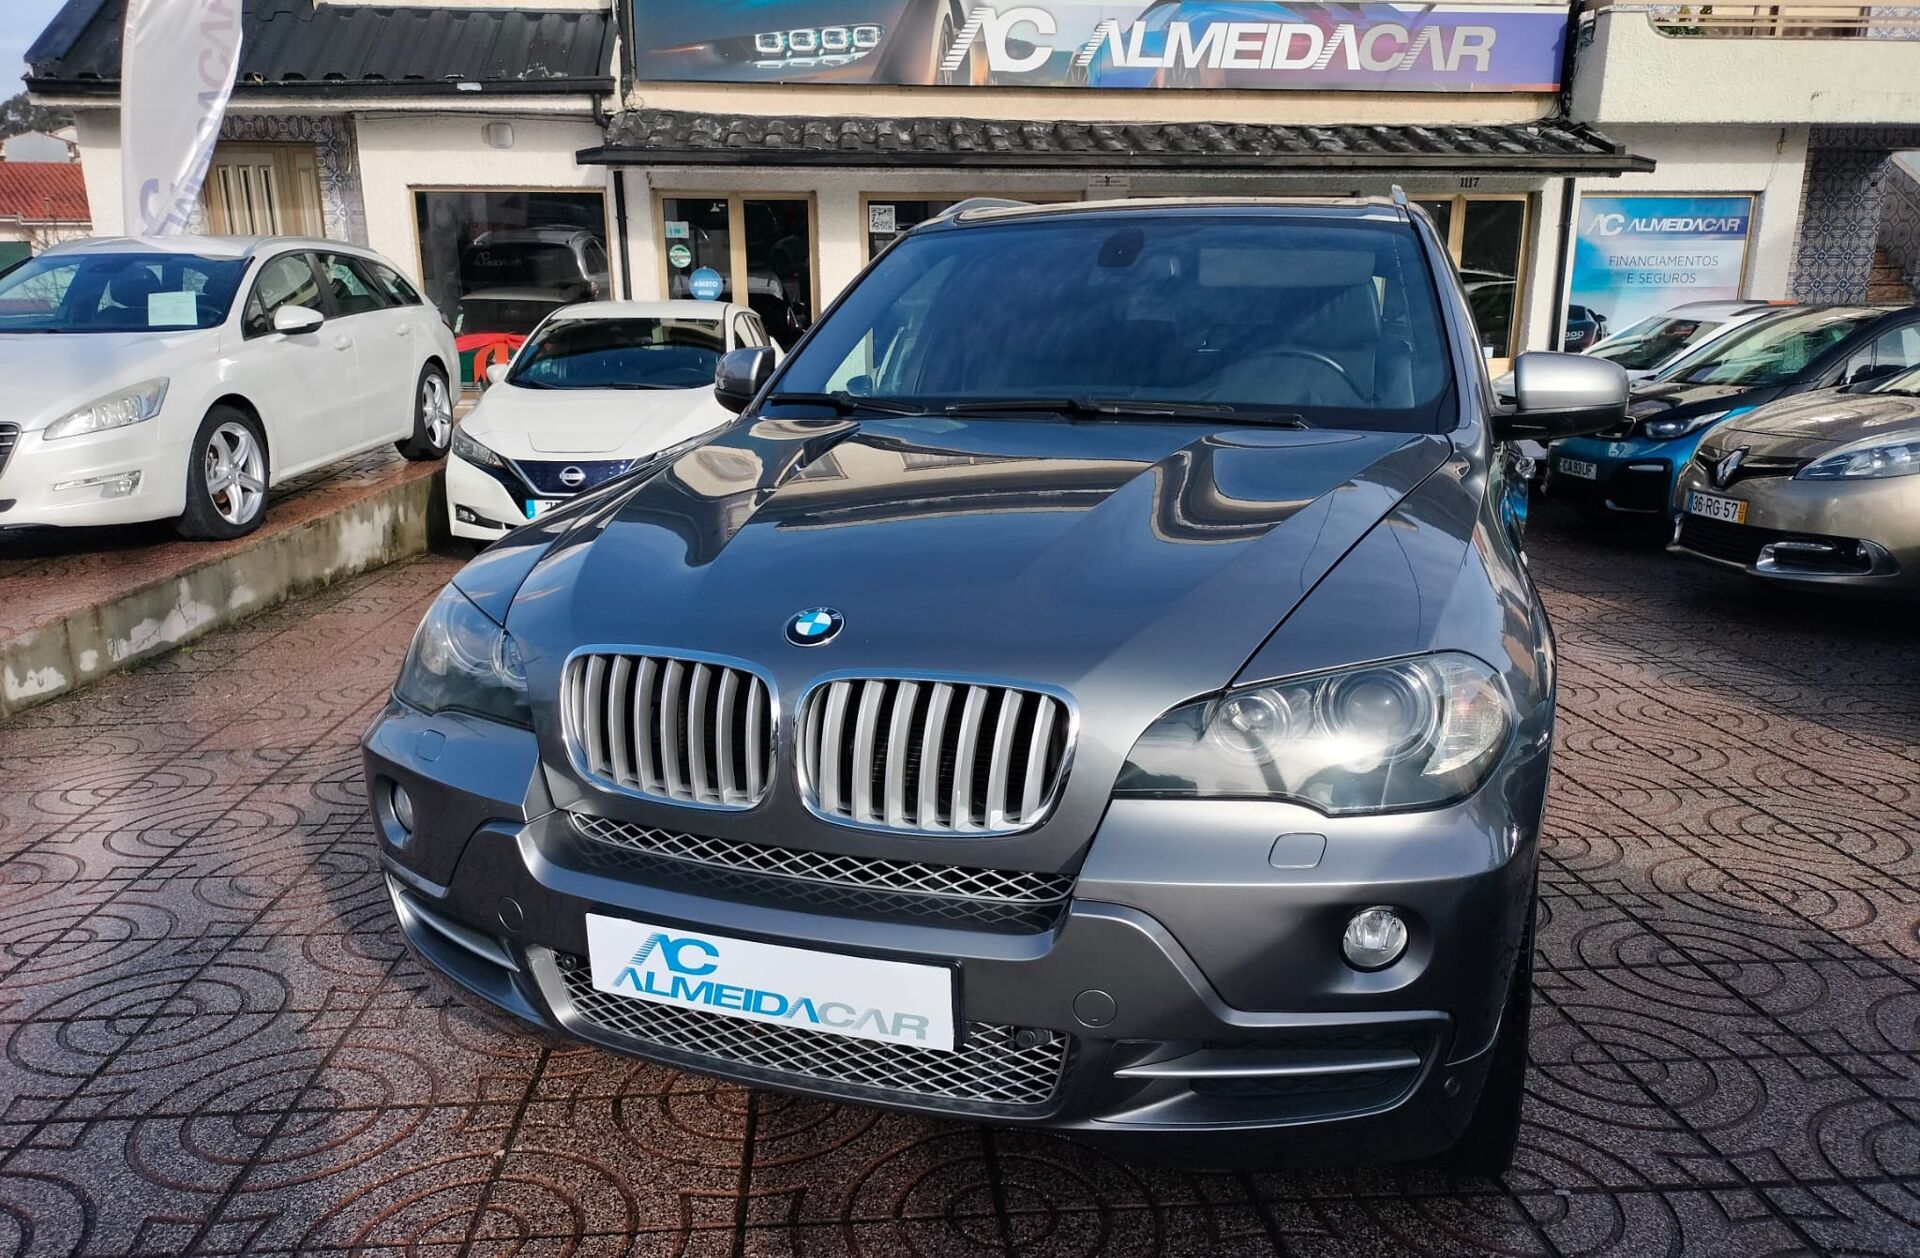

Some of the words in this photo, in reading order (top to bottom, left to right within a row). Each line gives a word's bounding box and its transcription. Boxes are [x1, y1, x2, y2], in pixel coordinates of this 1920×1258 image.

[940, 6, 1057, 73] AC
[1076, 18, 1496, 72] ALMEIDACAR
[1460, 177, 1480, 188] 1117
[1586, 213, 1625, 236] AC
[1628, 217, 1740, 232] ALMEIDACAR
[1608, 255, 1719, 267] FINANCIAMENTOS
[1626, 272, 1635, 284] E
[1639, 272, 1696, 284] SEGUROS
[629, 932, 720, 976] AC
[611, 966, 930, 1041] ALMEIDACAR
